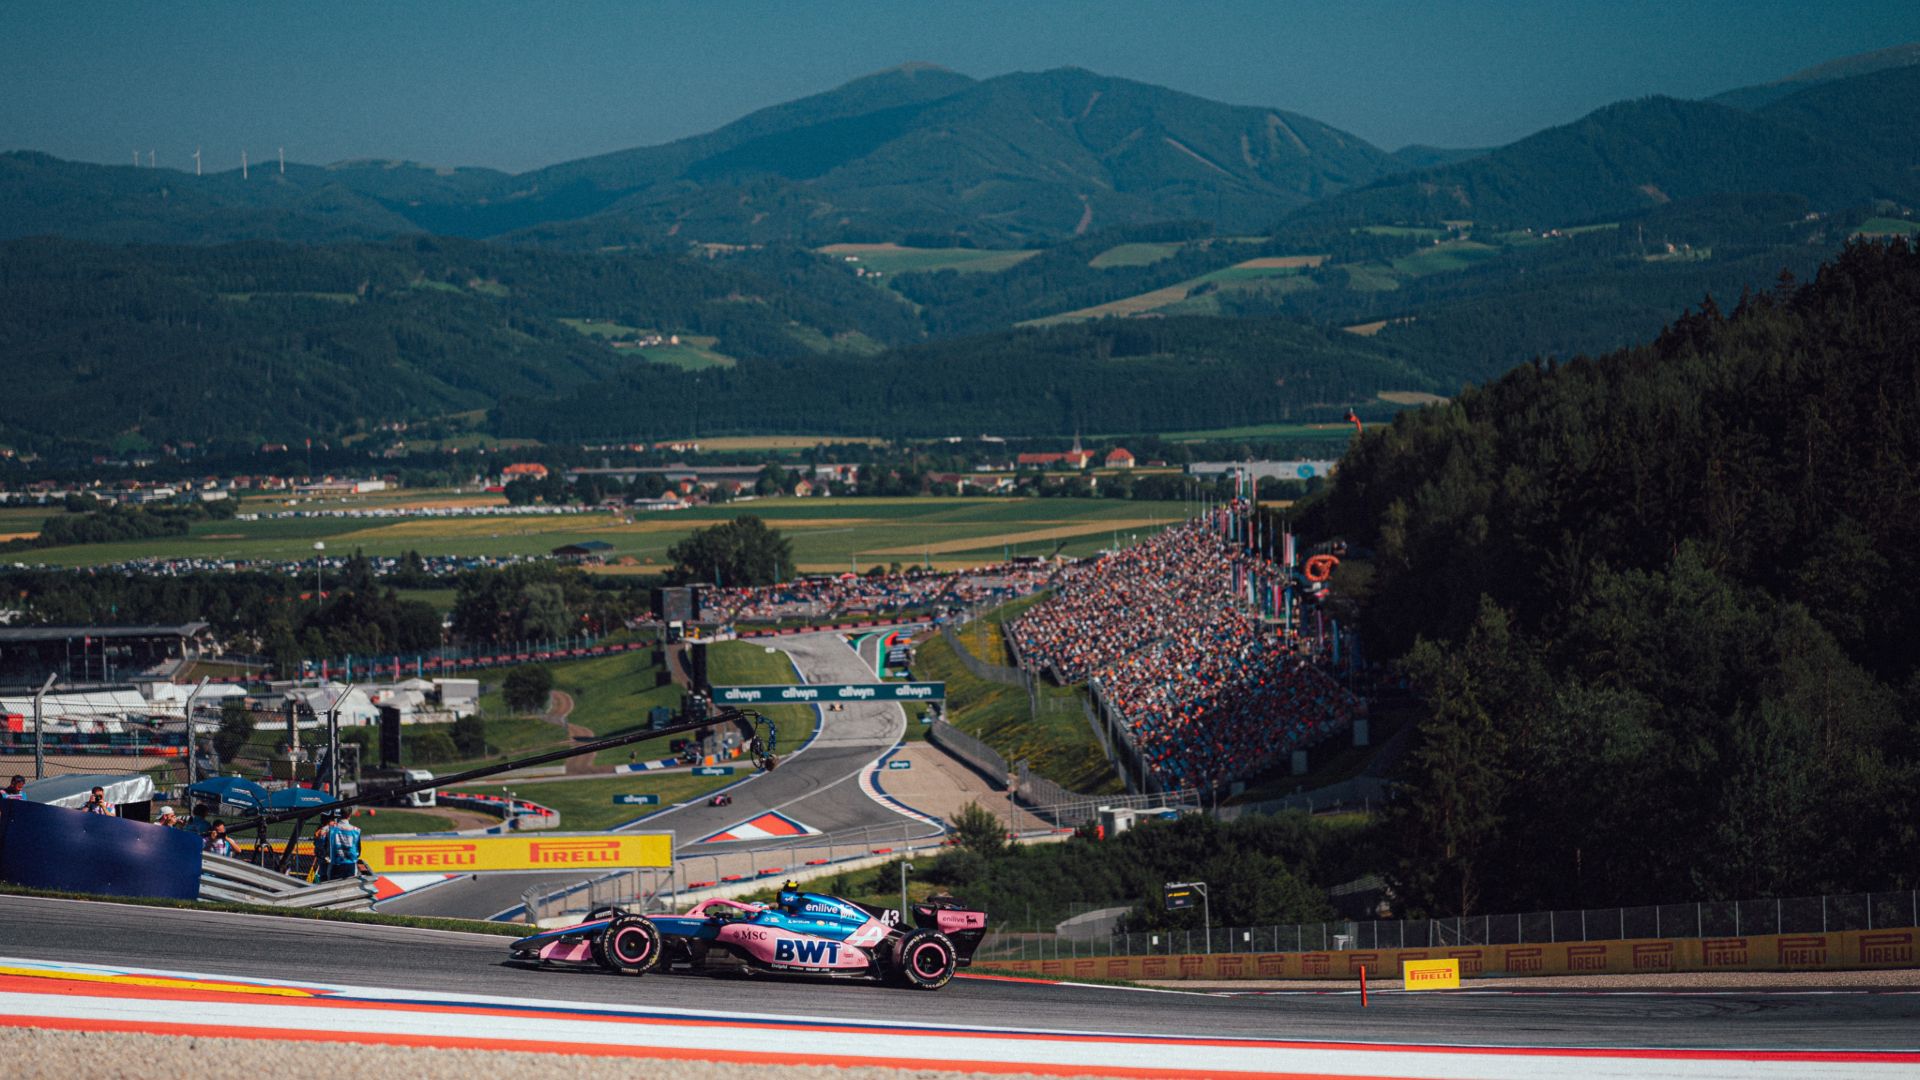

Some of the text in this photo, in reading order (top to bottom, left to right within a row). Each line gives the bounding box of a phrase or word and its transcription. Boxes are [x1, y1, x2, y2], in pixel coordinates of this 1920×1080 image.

[725, 688, 761, 701] allwyn
[782, 687, 818, 700] allwyn
[839, 686, 875, 699] allwyn
[896, 685, 932, 698] allwyn
[384, 844, 477, 866] PIRELLI
[529, 841, 621, 863] PIRELLI
[805, 903, 838, 914] enilive
[880, 909, 900, 927] 43
[741, 930, 767, 940] MSC
[774, 938, 841, 964] BWT
[1567, 945, 1607, 970] PIRELLI
[1632, 942, 1674, 969] PIRELLI
[1703, 938, 1748, 966] PIRELLI
[1778, 936, 1826, 965] PIRELLI
[1859, 933, 1913, 963] PIRELLI
[1505, 948, 1542, 972] PIRELLI
[1410, 968, 1452, 981] PIRELLI
